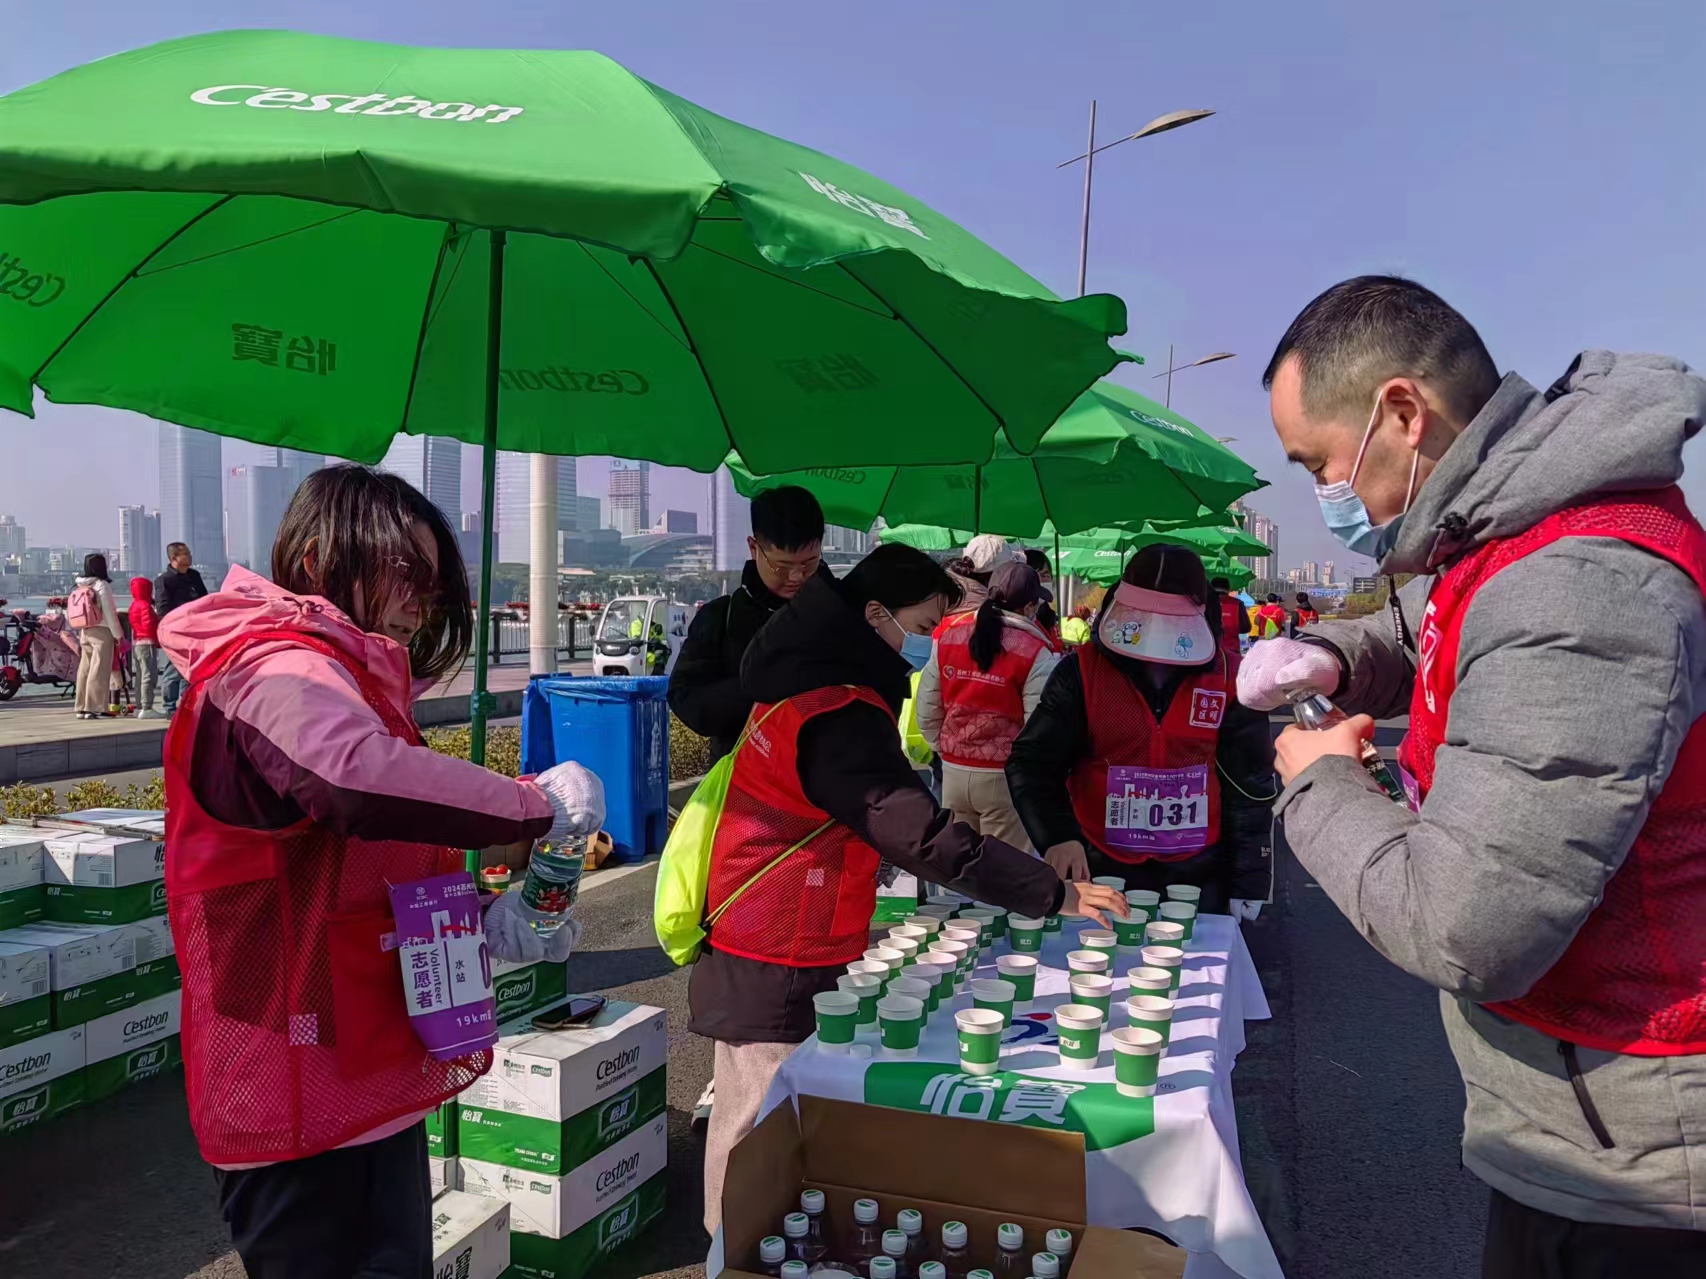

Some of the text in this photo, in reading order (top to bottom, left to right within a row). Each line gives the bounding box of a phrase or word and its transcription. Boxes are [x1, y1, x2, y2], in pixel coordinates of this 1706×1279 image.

[1393, 606, 1404, 646] ENERGY
[1149, 801, 1198, 827] 031
[410, 951, 433, 1009] 志愿者
[430, 948, 444, 1005] Volunteer
[455, 959, 466, 984] 水站
[919, 1073, 1087, 1125] 怡寶
